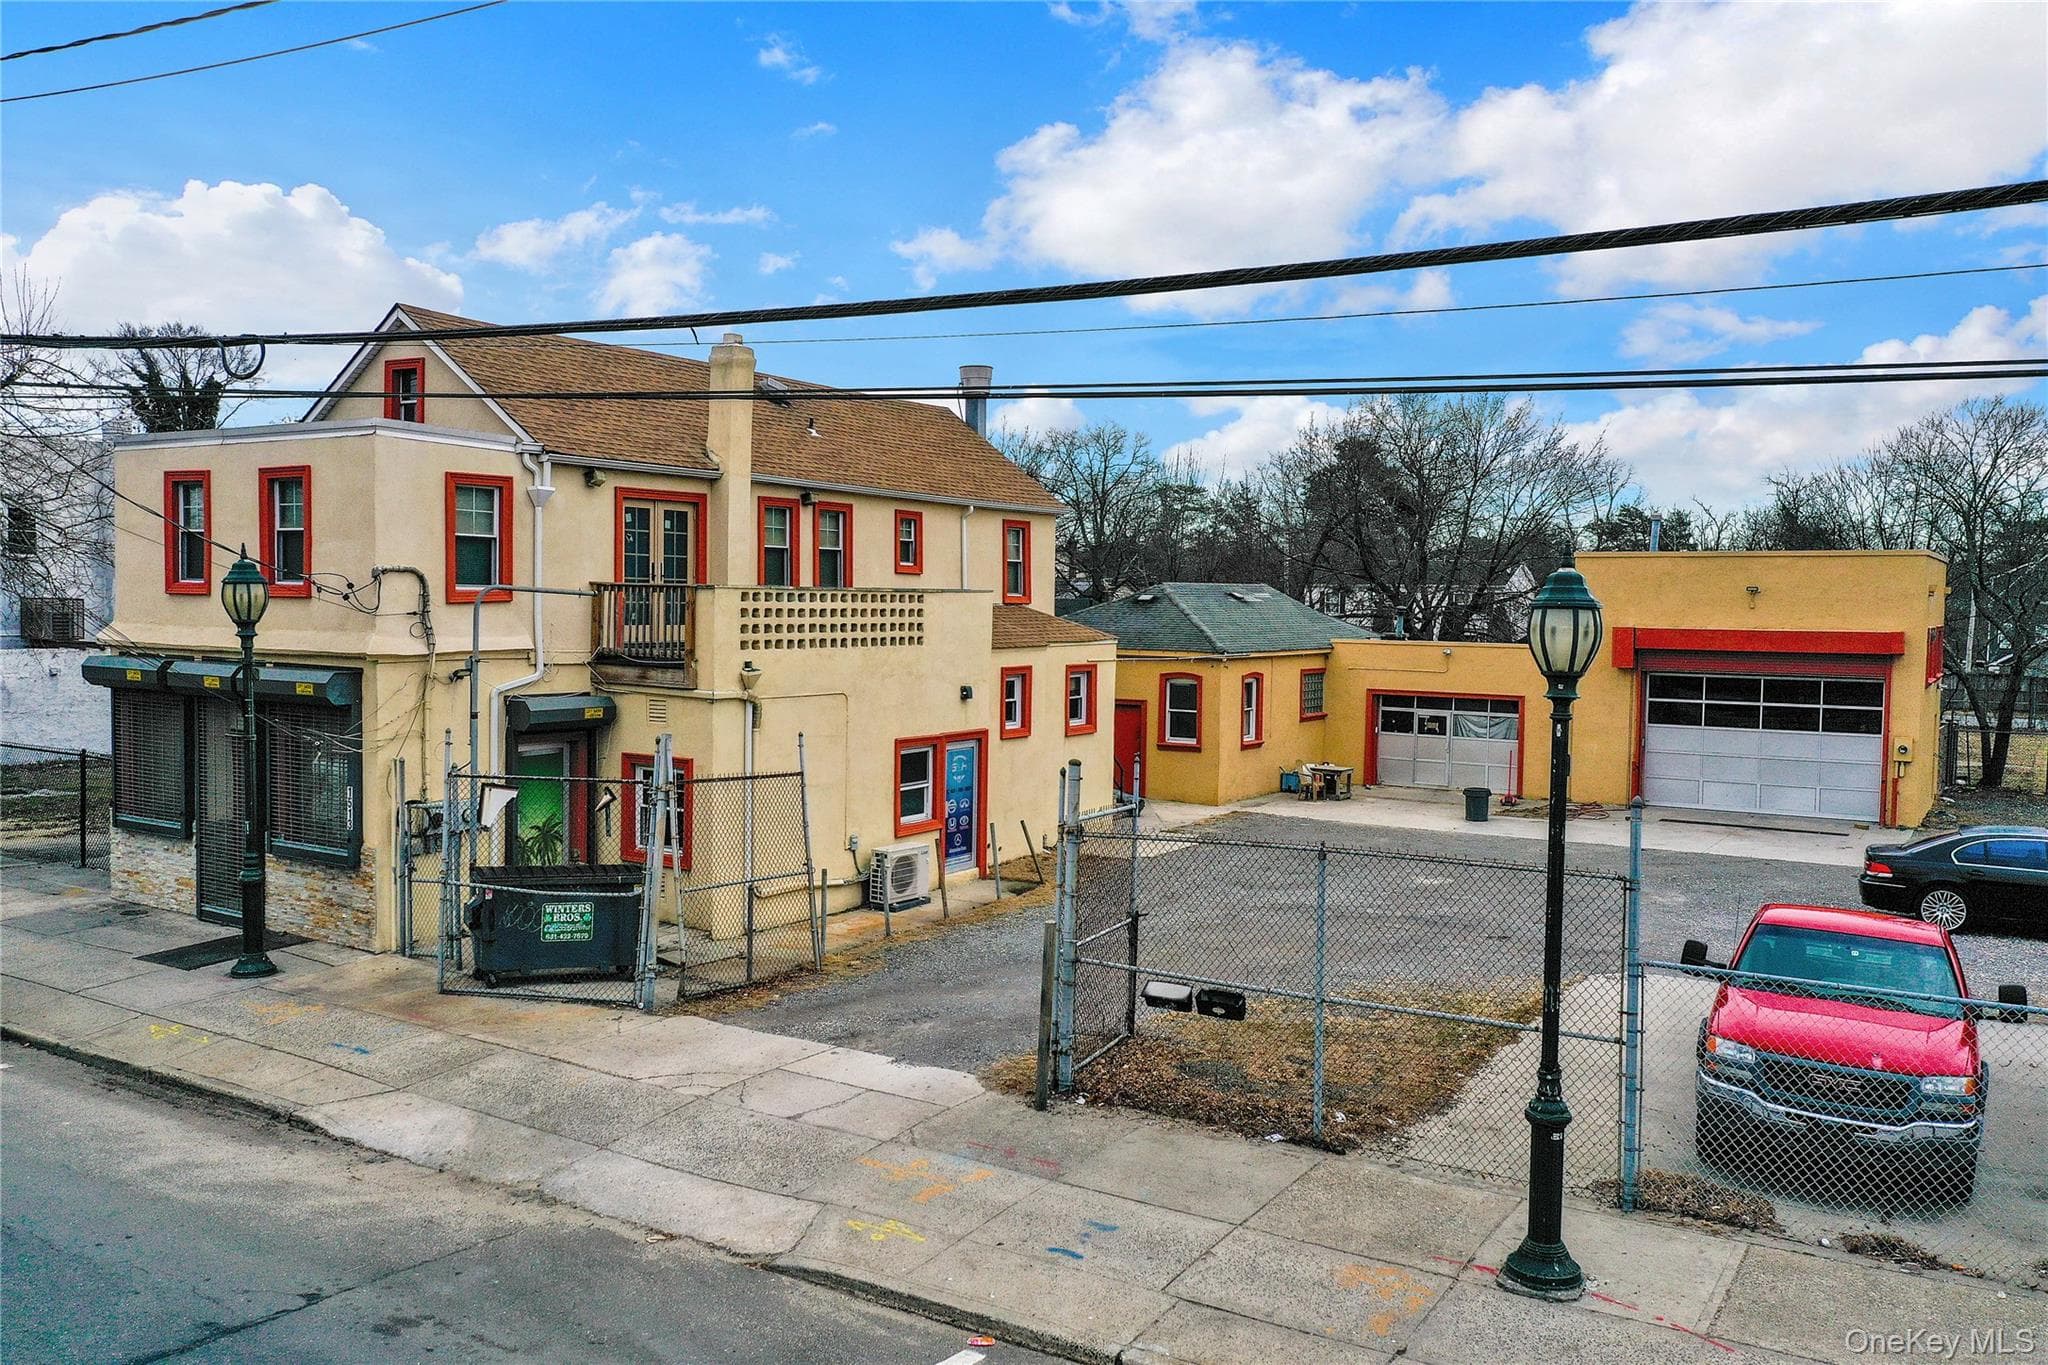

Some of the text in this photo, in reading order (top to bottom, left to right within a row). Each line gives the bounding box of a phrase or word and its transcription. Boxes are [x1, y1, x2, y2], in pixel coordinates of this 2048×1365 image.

[544, 903, 592, 913] WINTERS
[553, 912, 583, 922] BROS.
[1808, 1073, 1861, 1092] GMC
